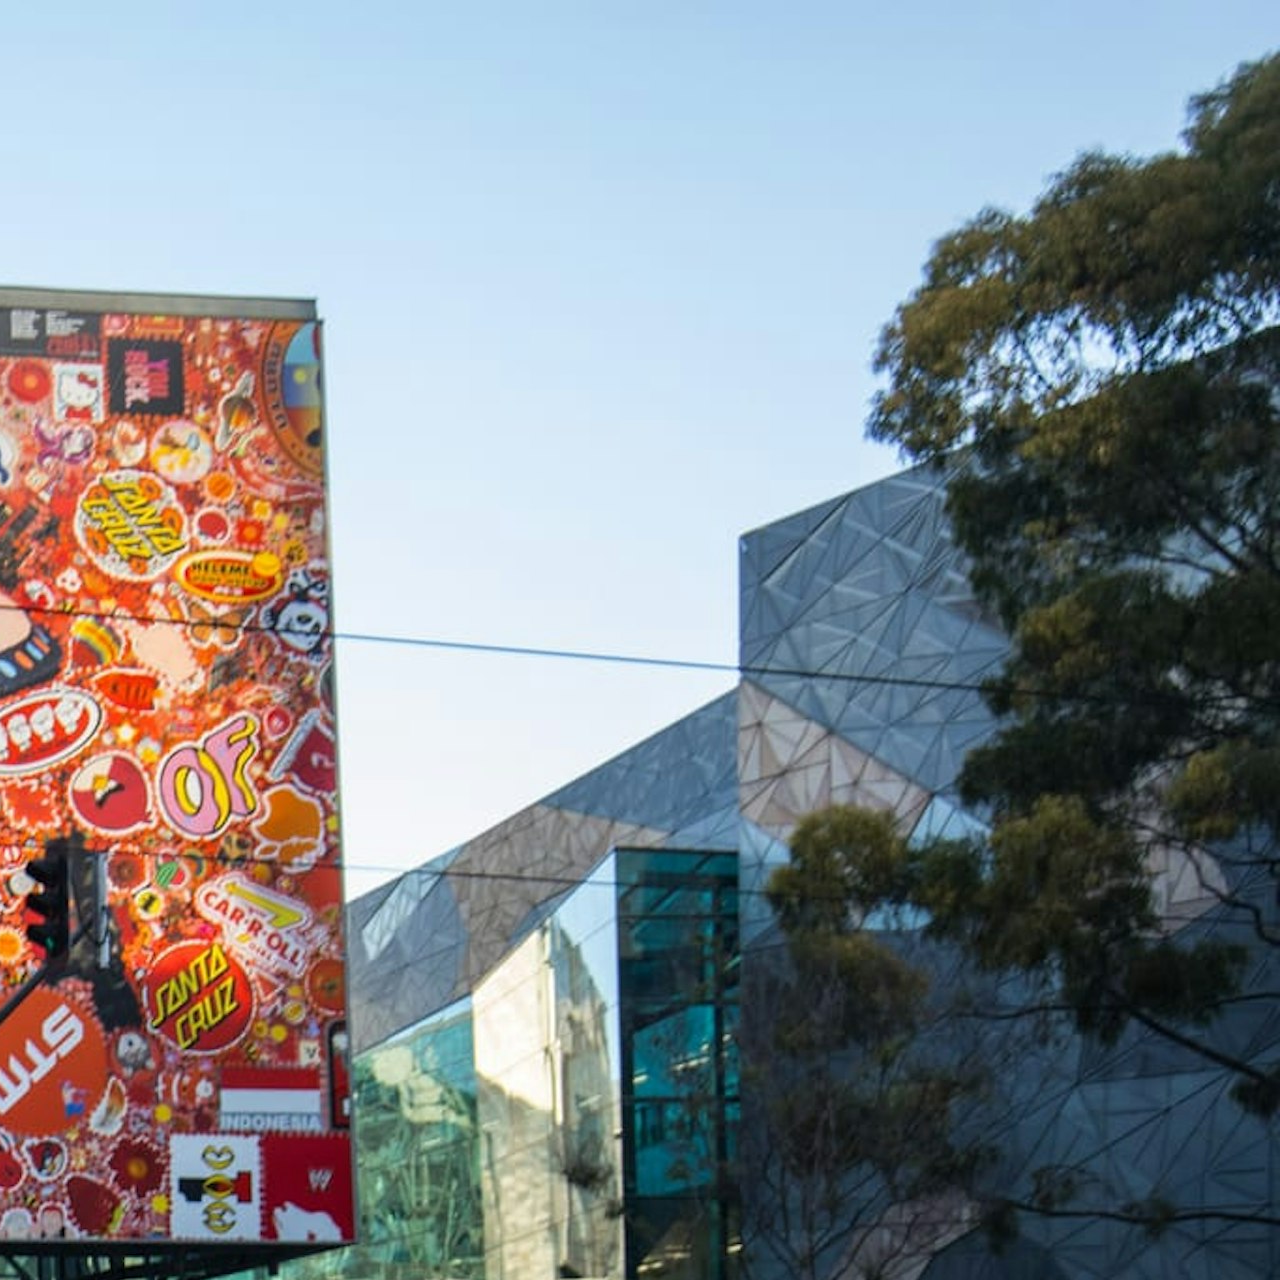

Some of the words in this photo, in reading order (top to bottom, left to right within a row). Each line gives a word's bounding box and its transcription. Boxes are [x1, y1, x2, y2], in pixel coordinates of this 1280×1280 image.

[152, 944, 230, 1028] SANTA
[175, 976, 241, 1050] CRUZ
[222, 1114, 322, 1131] INDONESIA
